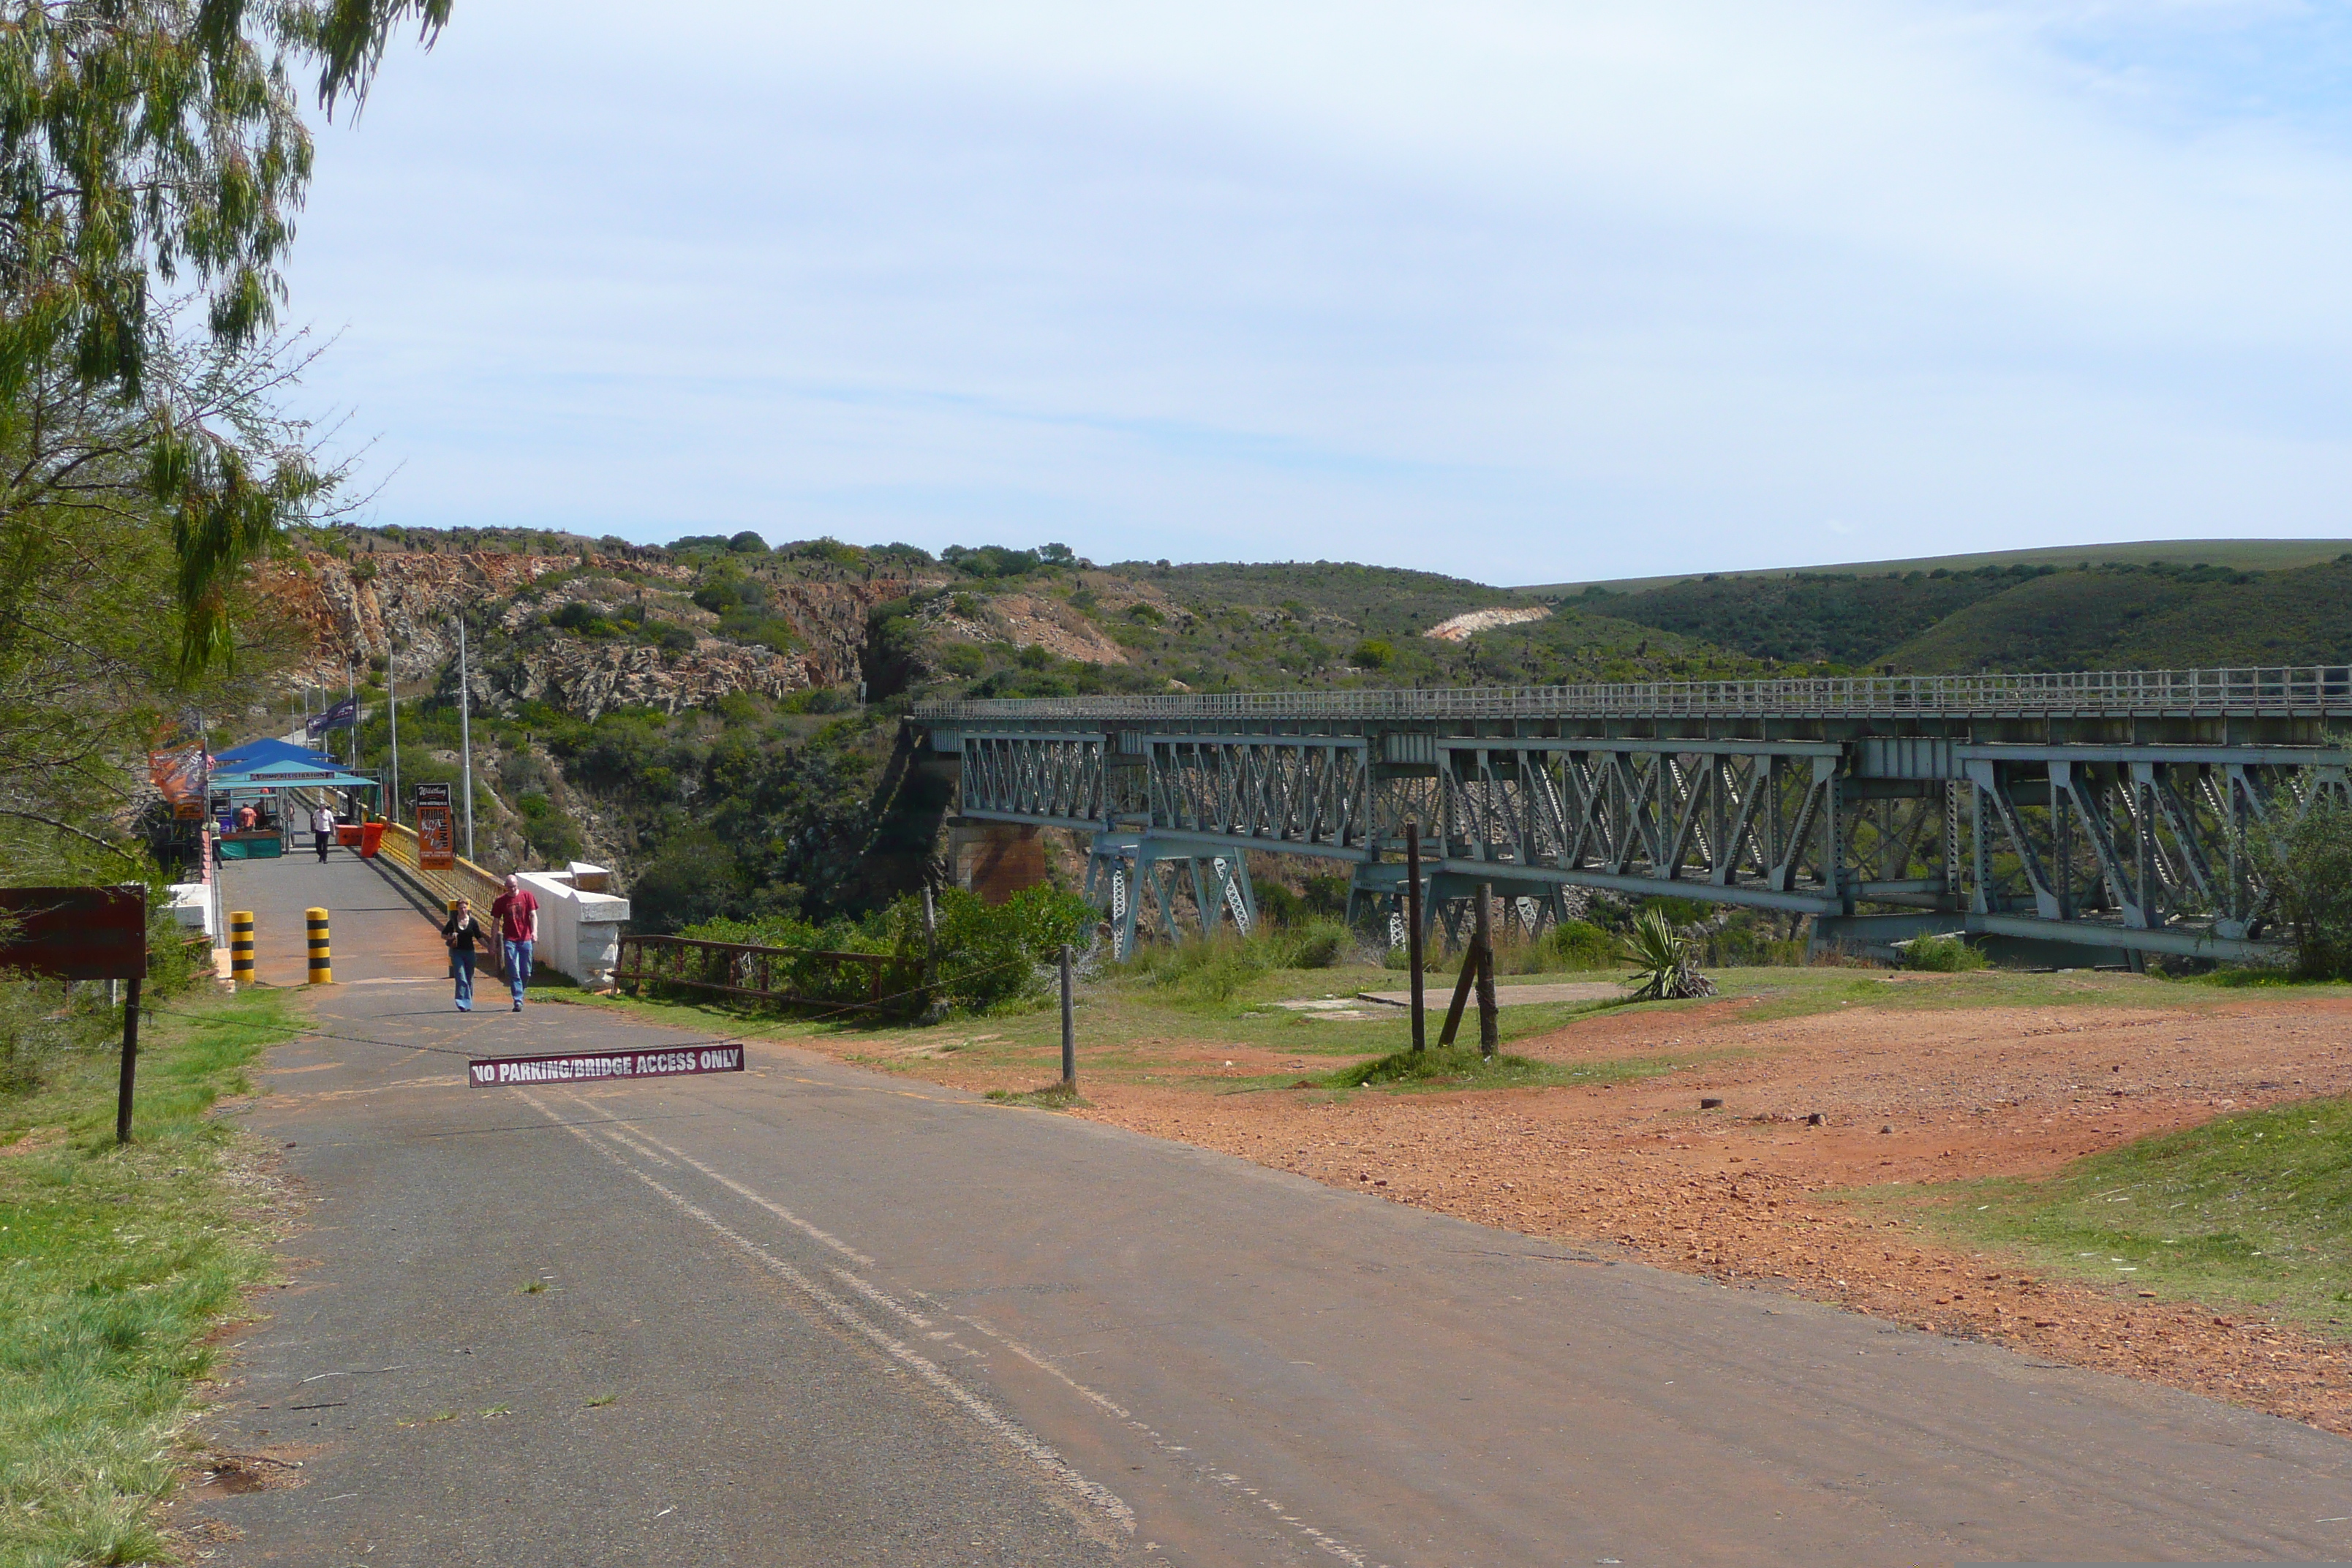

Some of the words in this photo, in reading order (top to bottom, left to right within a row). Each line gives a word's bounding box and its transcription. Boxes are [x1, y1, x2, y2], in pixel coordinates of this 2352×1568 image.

[421, 810, 447, 820] BRIDGE
[439, 823, 448, 847] JUMP
[472, 1064, 495, 1082] NO
[636, 1052, 696, 1074] ACCESS
[701, 1049, 739, 1069] ONLY
